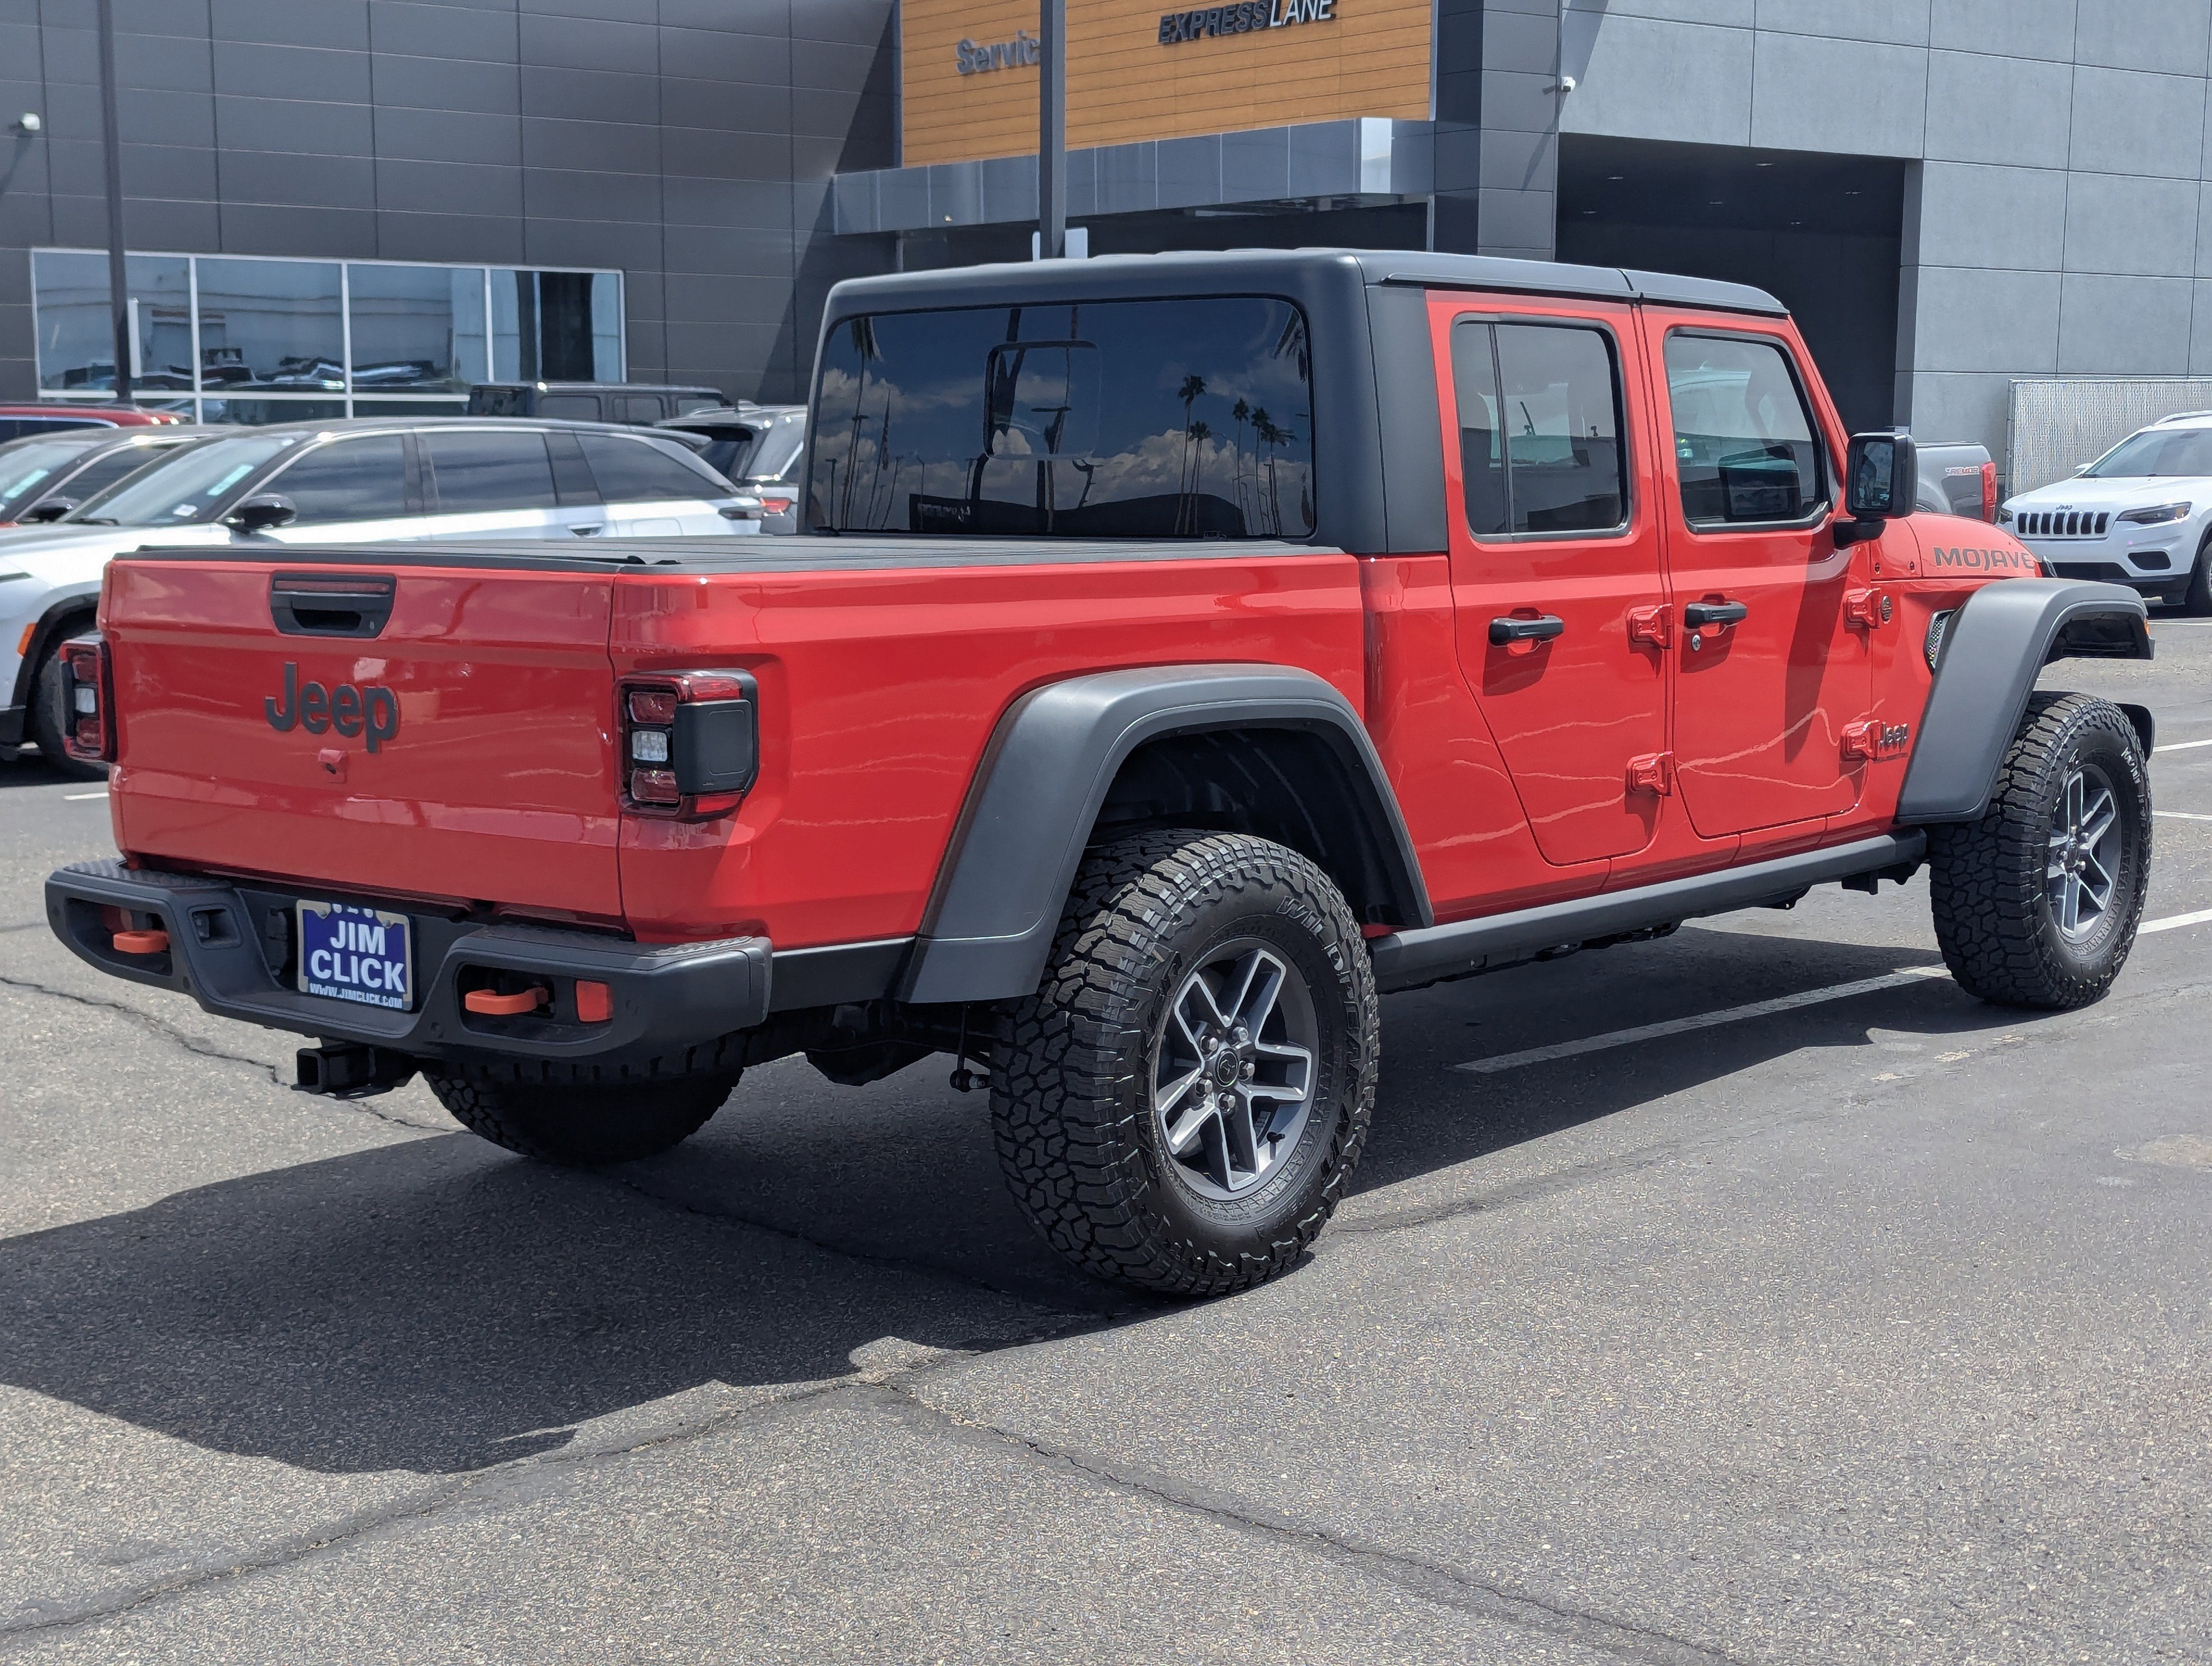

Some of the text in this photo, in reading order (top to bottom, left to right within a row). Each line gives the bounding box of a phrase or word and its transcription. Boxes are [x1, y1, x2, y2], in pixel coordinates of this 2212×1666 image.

[956, 30, 1040, 74] Servic
[1933, 547, 2034, 571] MOJAVE
[264, 661, 400, 753] Jeep
[1879, 721, 1908, 749] Jeep
[330, 920, 385, 956] JIM
[311, 950, 405, 992] CLICK
[310, 983, 403, 1009] WWW.JIMCLICK.COM
